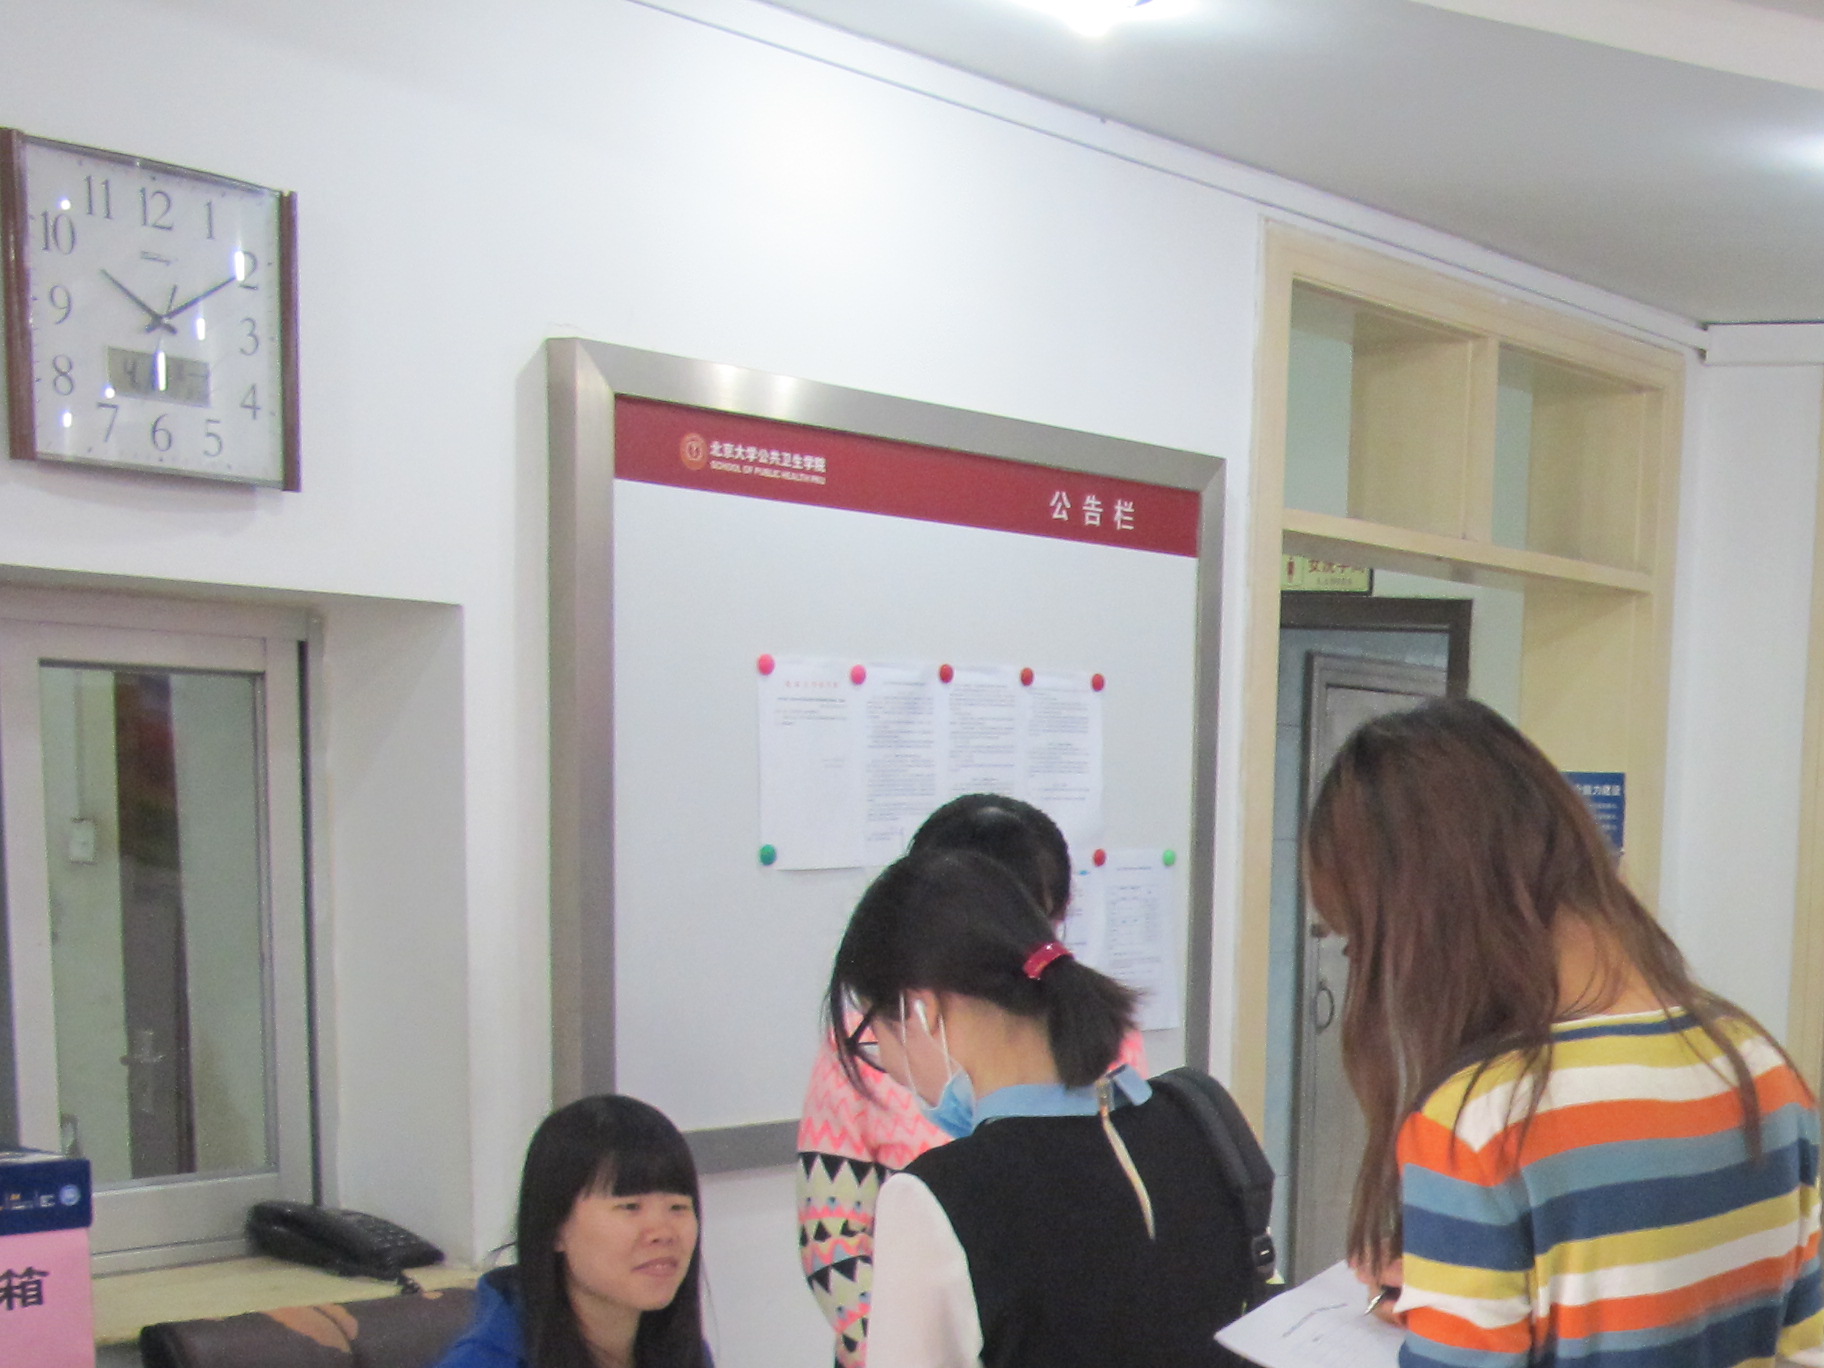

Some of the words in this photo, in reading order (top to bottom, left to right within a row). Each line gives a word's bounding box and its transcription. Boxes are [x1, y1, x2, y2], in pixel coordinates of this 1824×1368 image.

[86, 176, 113, 219] 11
[140, 188, 173, 231] 12
[41, 211, 76, 255] 10
[204, 202, 216, 240] 1
[50, 285, 72, 325] 9
[239, 318, 260, 356] 3
[52, 354, 75, 396] 8
[98, 402, 120, 442] 7
[239, 384, 261, 420] 4
[150, 414, 173, 452] 6
[203, 419, 224, 457] 5
[710, 440, 827, 473] 北京大学公共卫生学院
[1049, 490, 1136, 531] 公告栏
